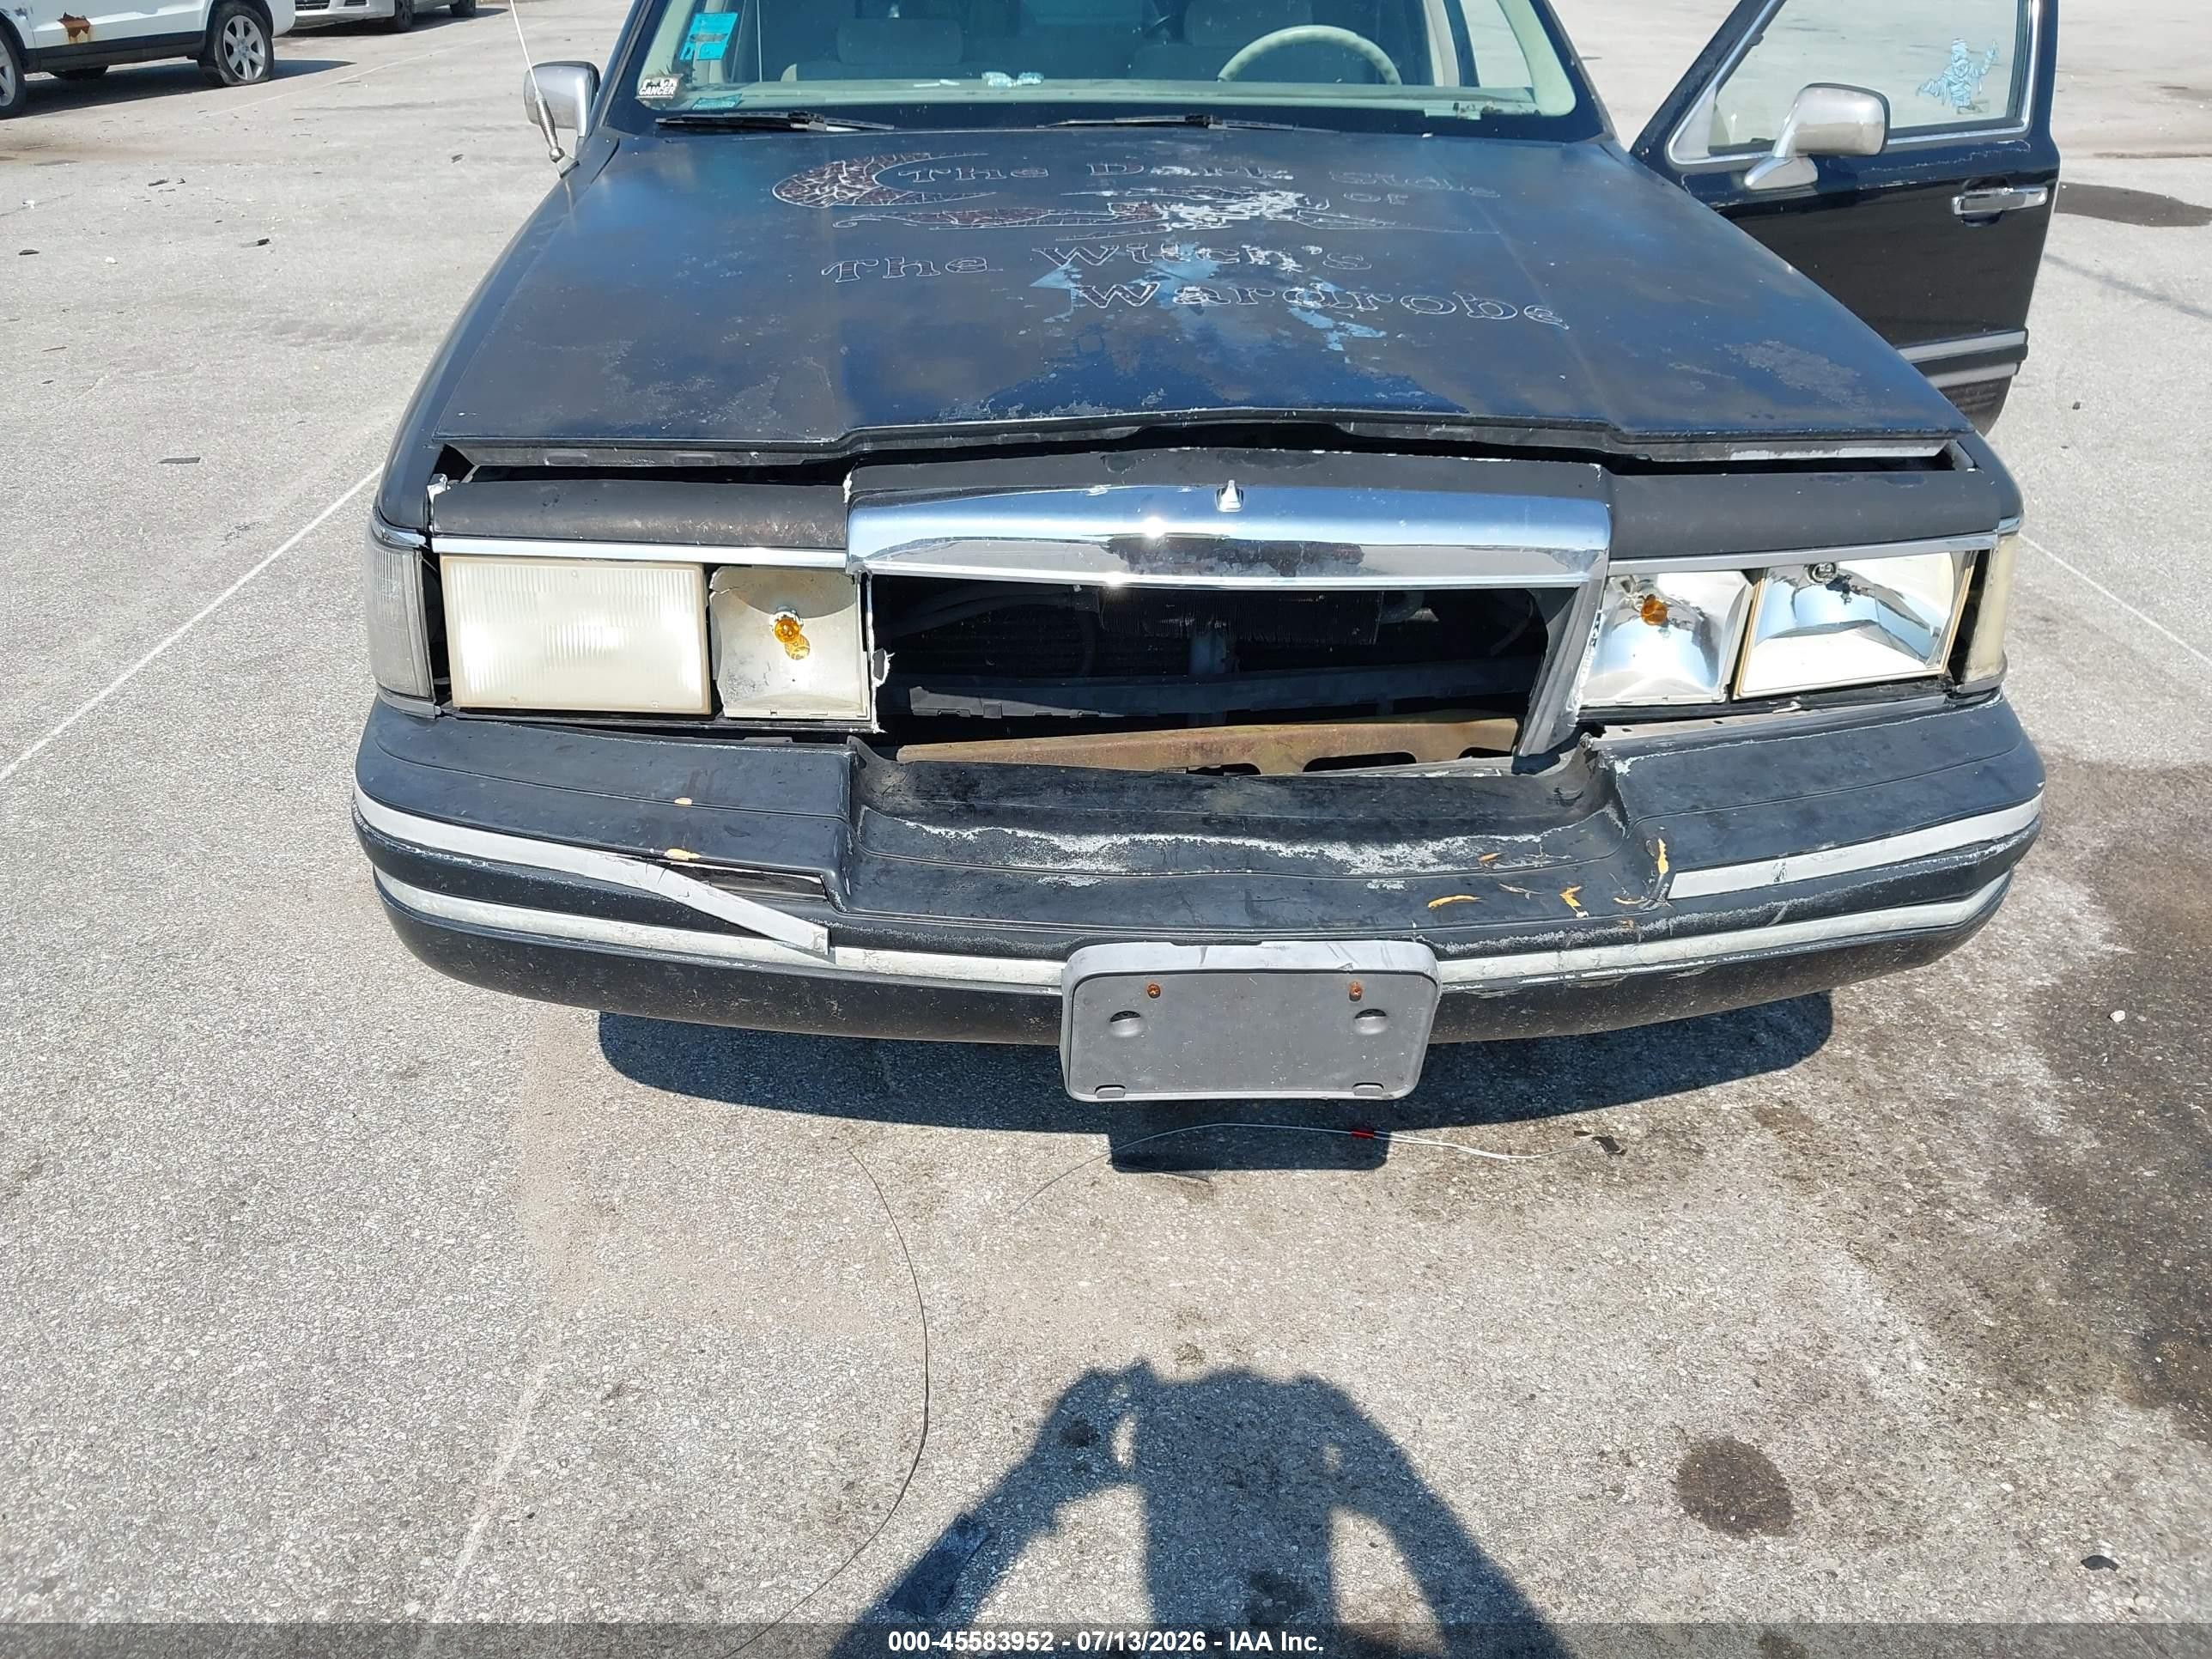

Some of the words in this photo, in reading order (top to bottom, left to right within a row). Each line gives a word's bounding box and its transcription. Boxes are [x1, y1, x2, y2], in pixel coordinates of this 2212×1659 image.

[638, 86, 675, 96] CANCER
[898, 164, 1050, 183] The
[820, 256, 989, 283] The
[1030, 241, 1373, 273] Witch's
[1076, 281, 1571, 331] Wardrobe
